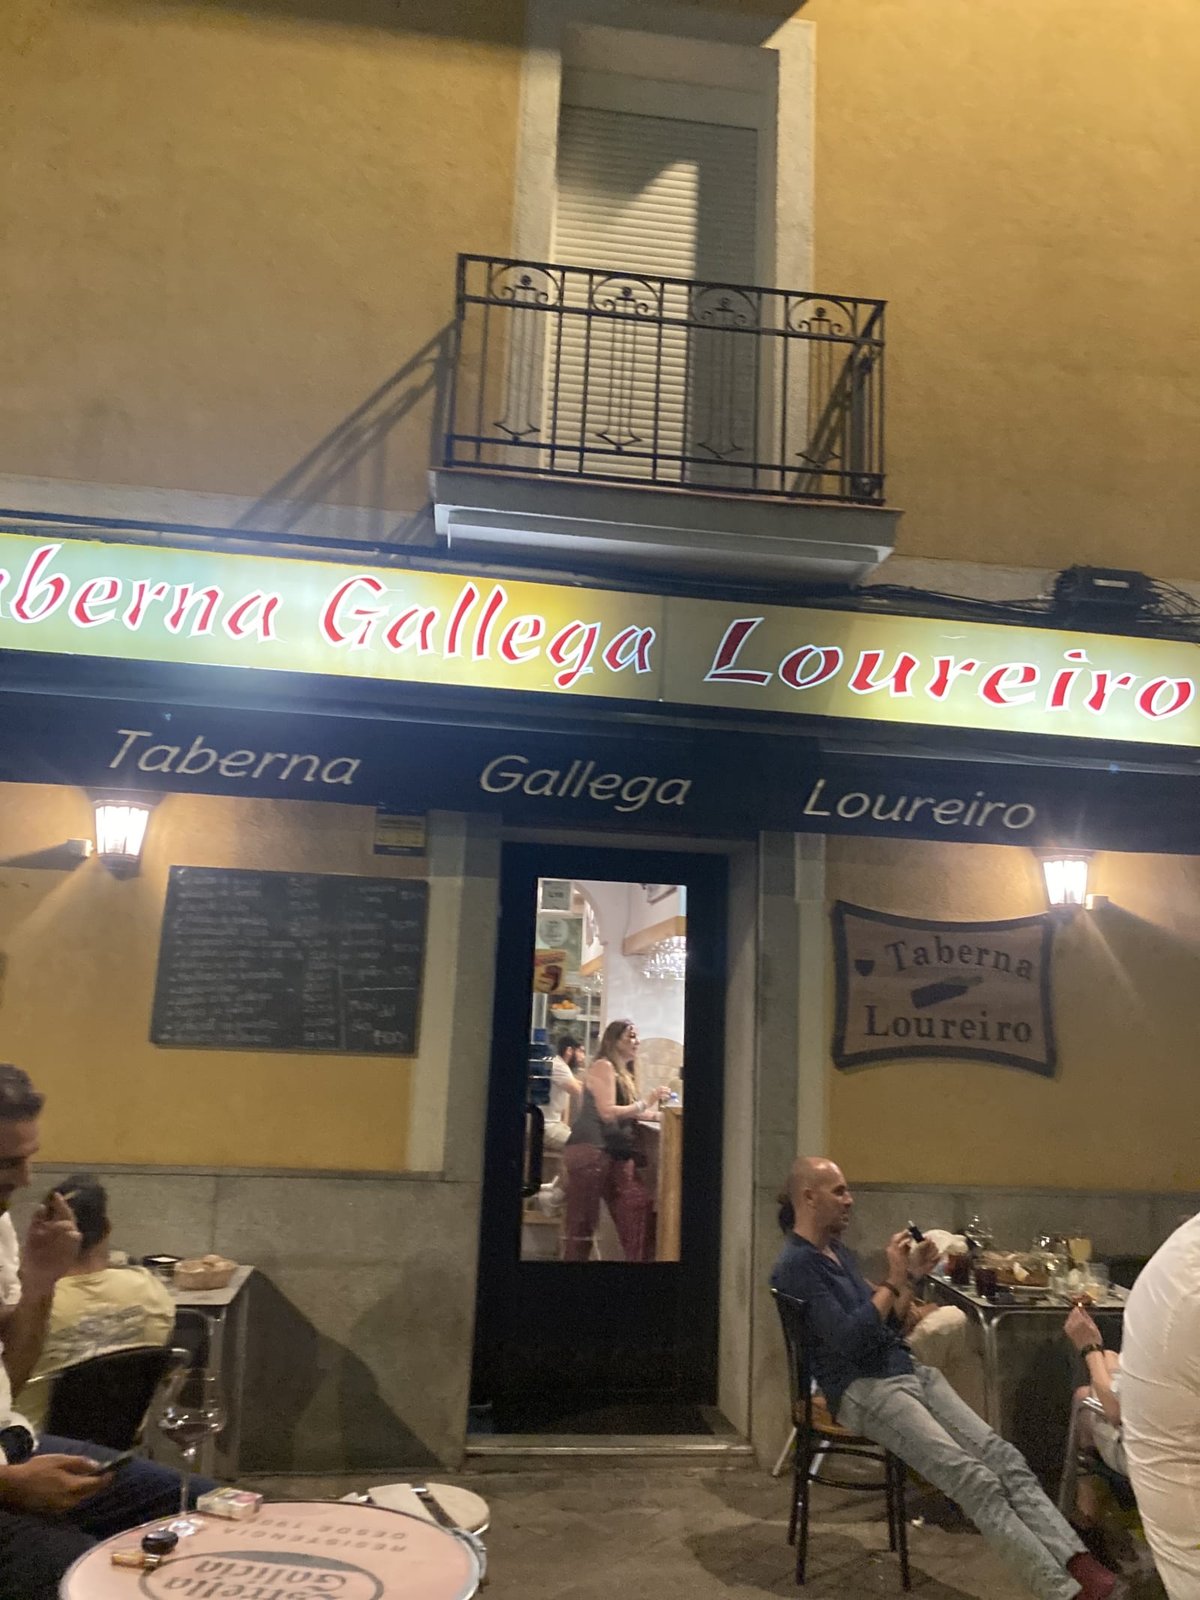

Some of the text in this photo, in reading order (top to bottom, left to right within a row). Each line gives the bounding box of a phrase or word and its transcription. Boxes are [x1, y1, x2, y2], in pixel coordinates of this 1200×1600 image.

[0, 544, 1196, 721] berna Gallega Loureiro
[108, 728, 1037, 829] Taberna Gallega Loureiro
[885, 936, 1034, 980] Taberna
[864, 1005, 1032, 1043] Loureiro
[223, 1527, 406, 1552] RESISTENCIA
[318, 1525, 406, 1539] DESDE
[195, 1560, 347, 1592] Galicia
